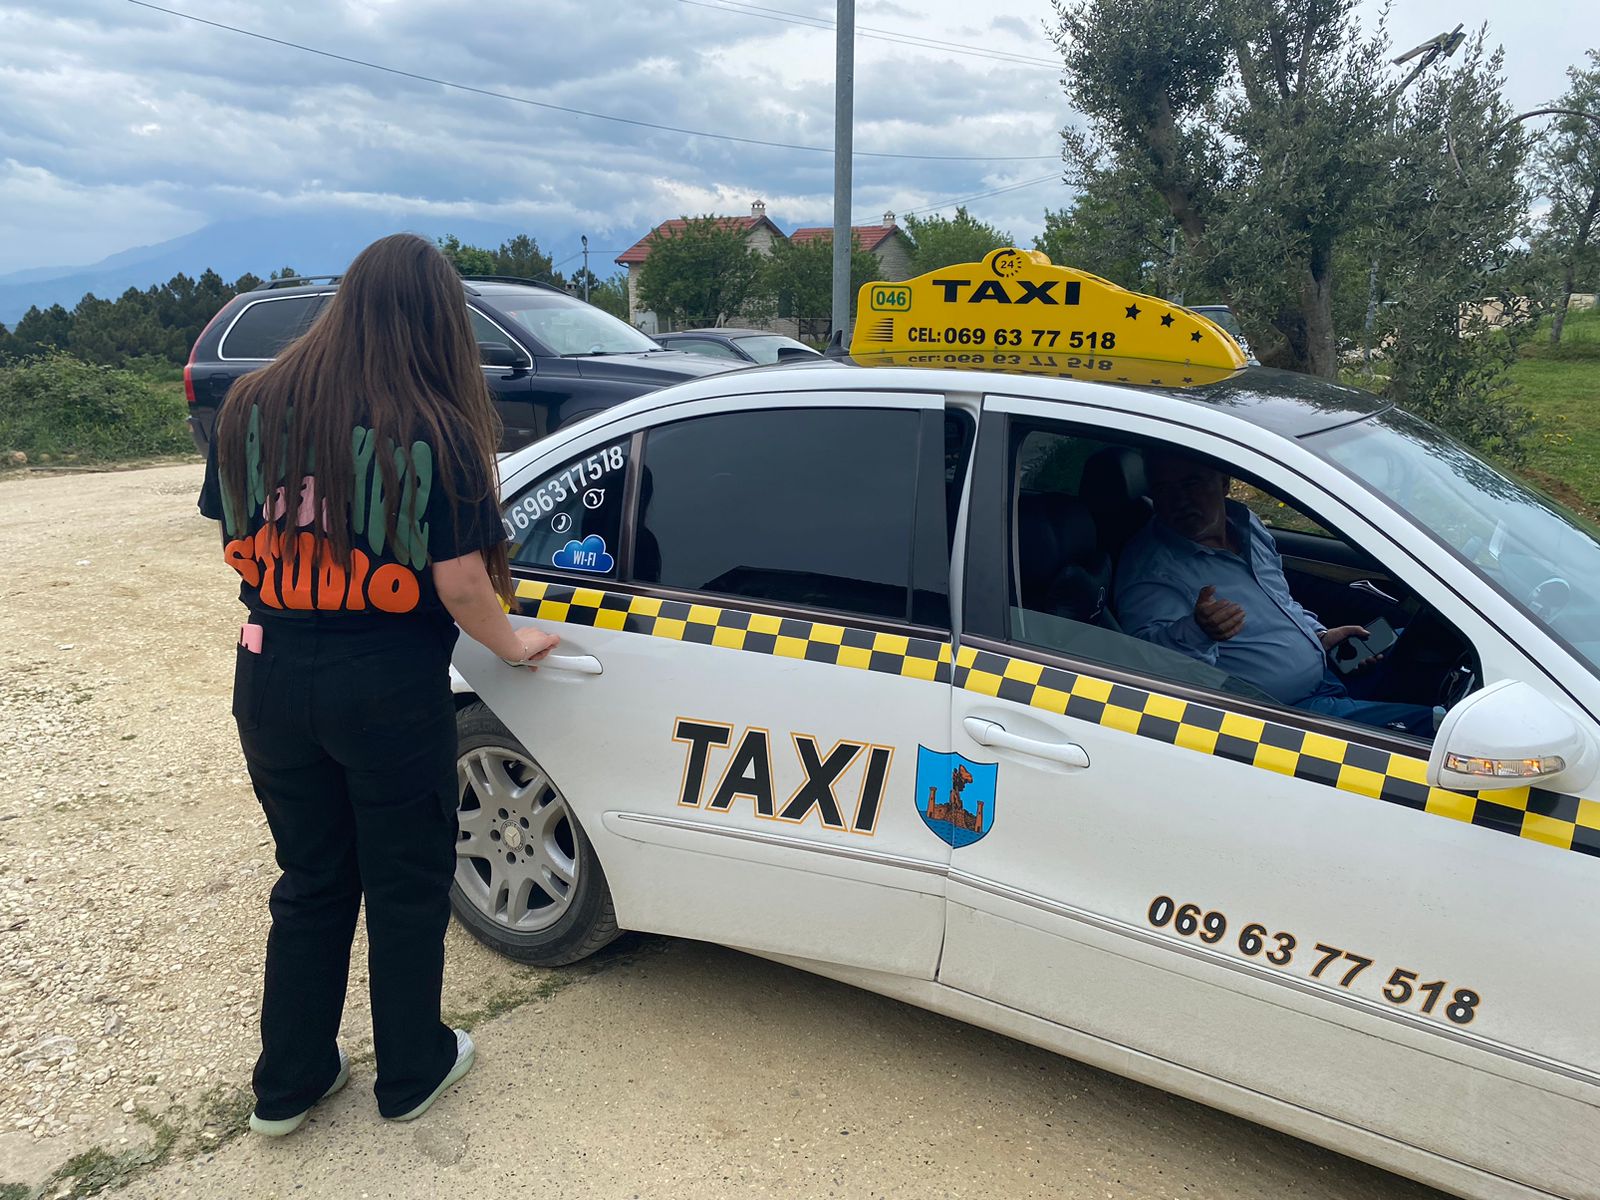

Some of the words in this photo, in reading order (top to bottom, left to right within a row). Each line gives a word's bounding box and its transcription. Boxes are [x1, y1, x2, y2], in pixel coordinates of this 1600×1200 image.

[1000, 260, 1014, 269] 24
[876, 290, 907, 306] 046
[932, 279, 1081, 305] TAXI
[994, 328, 1022, 347] 63
[1031, 329, 1060, 348] 77
[1069, 331, 1116, 350] 518
[224, 523, 420, 613] STUDIO
[573, 550, 597, 567] WI-FI
[672, 716, 896, 836] TAXI
[1148, 895, 1227, 944] 069
[1238, 923, 1297, 966] 63
[1310, 942, 1376, 989] 77
[1382, 967, 1481, 1026] 518
